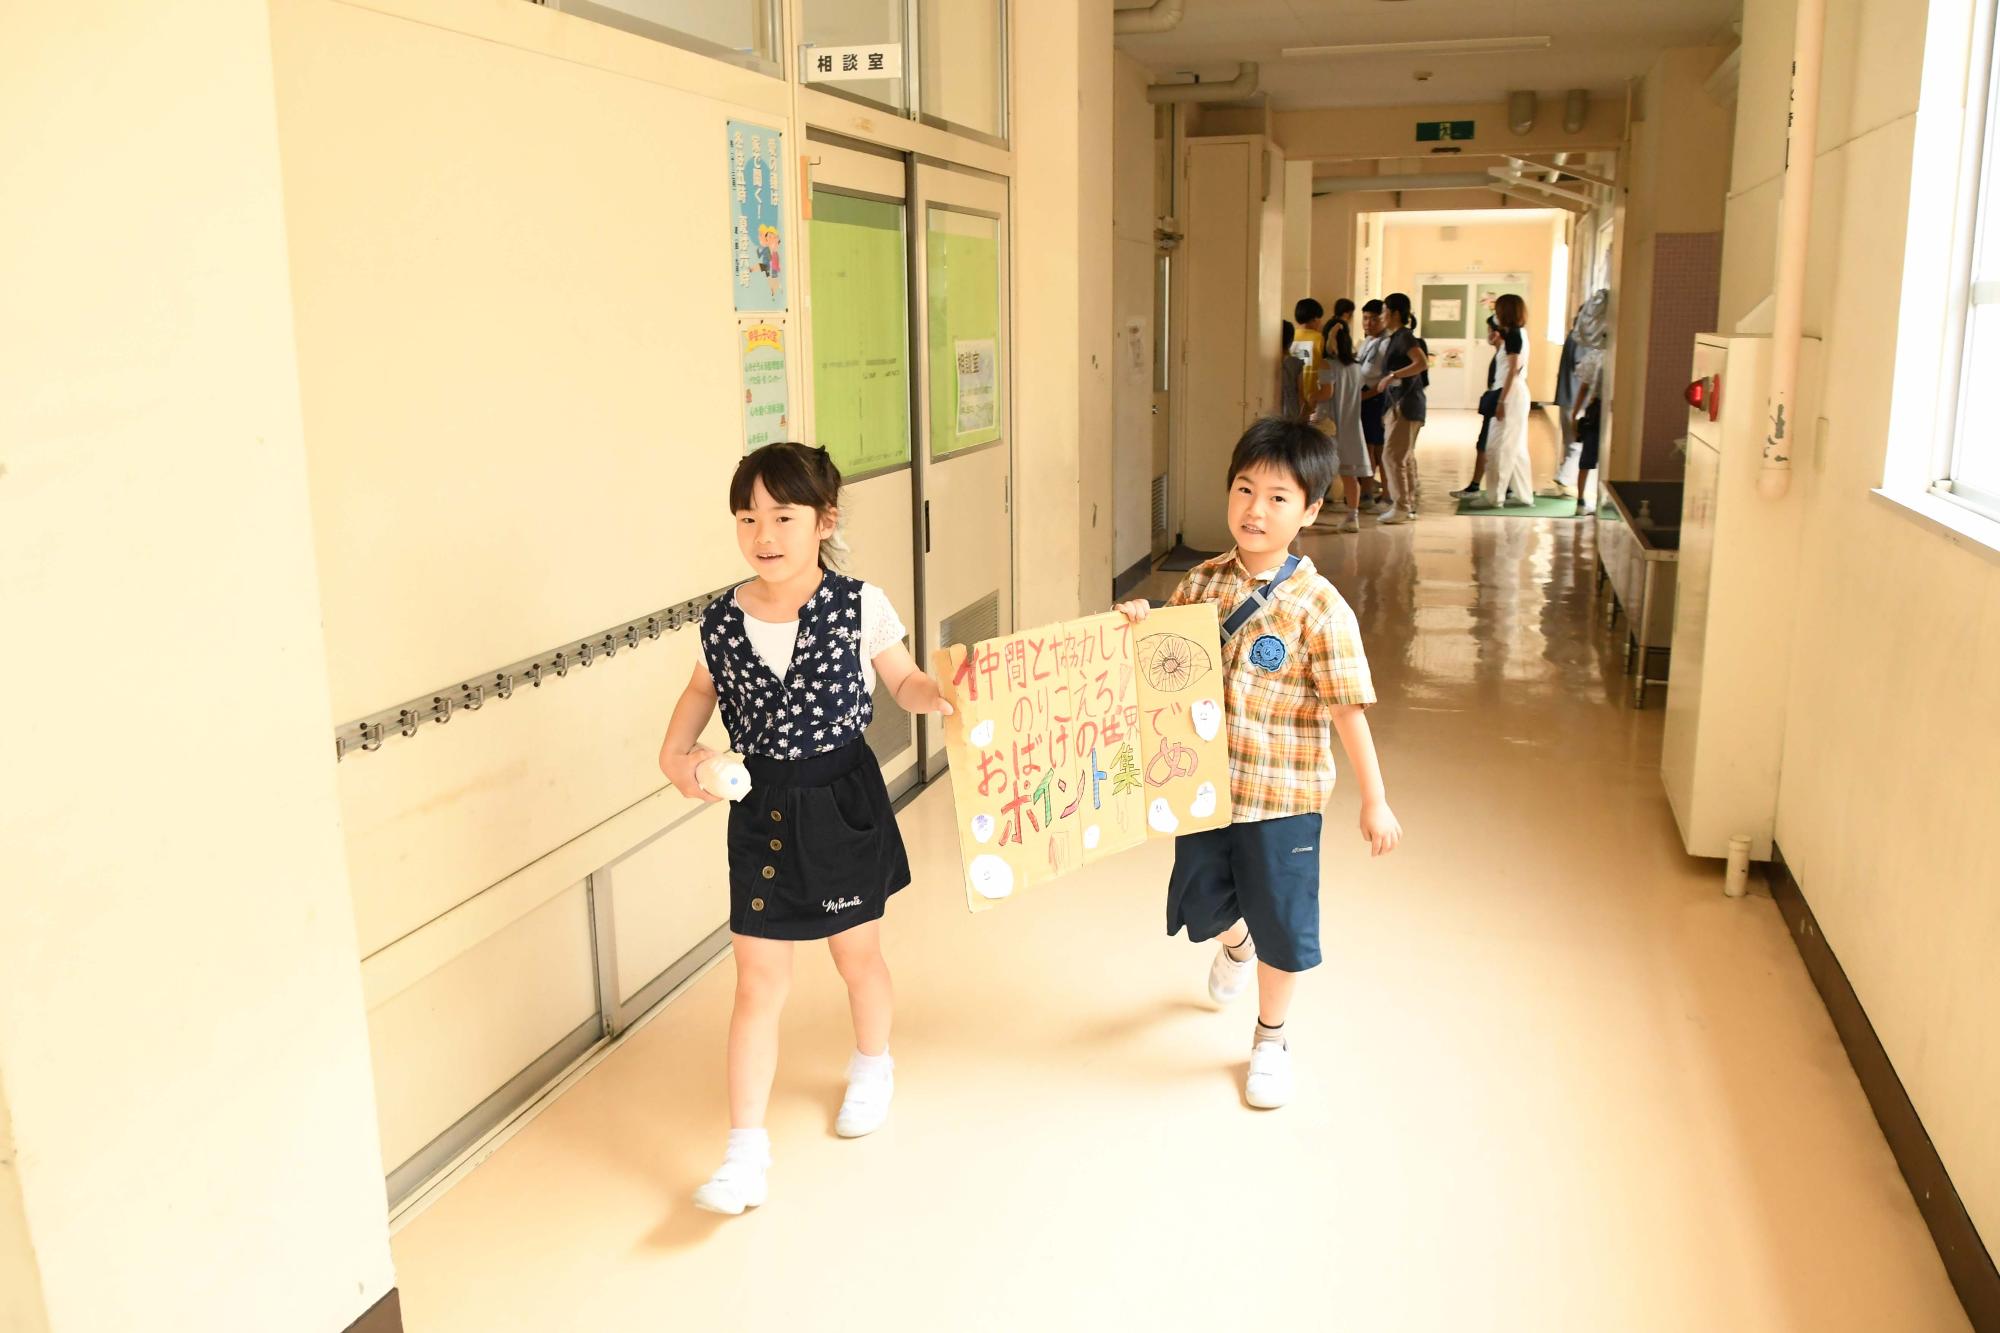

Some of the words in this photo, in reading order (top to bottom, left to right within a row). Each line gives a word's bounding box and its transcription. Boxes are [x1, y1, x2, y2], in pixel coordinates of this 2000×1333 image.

[817, 52, 884, 73] 相談室
[953, 622, 1130, 701] 仲間と協力して
[977, 702, 1182, 797] おばけの世界で
[998, 737, 1198, 846] ポイント集め
[822, 895, 863, 914] Minnie
